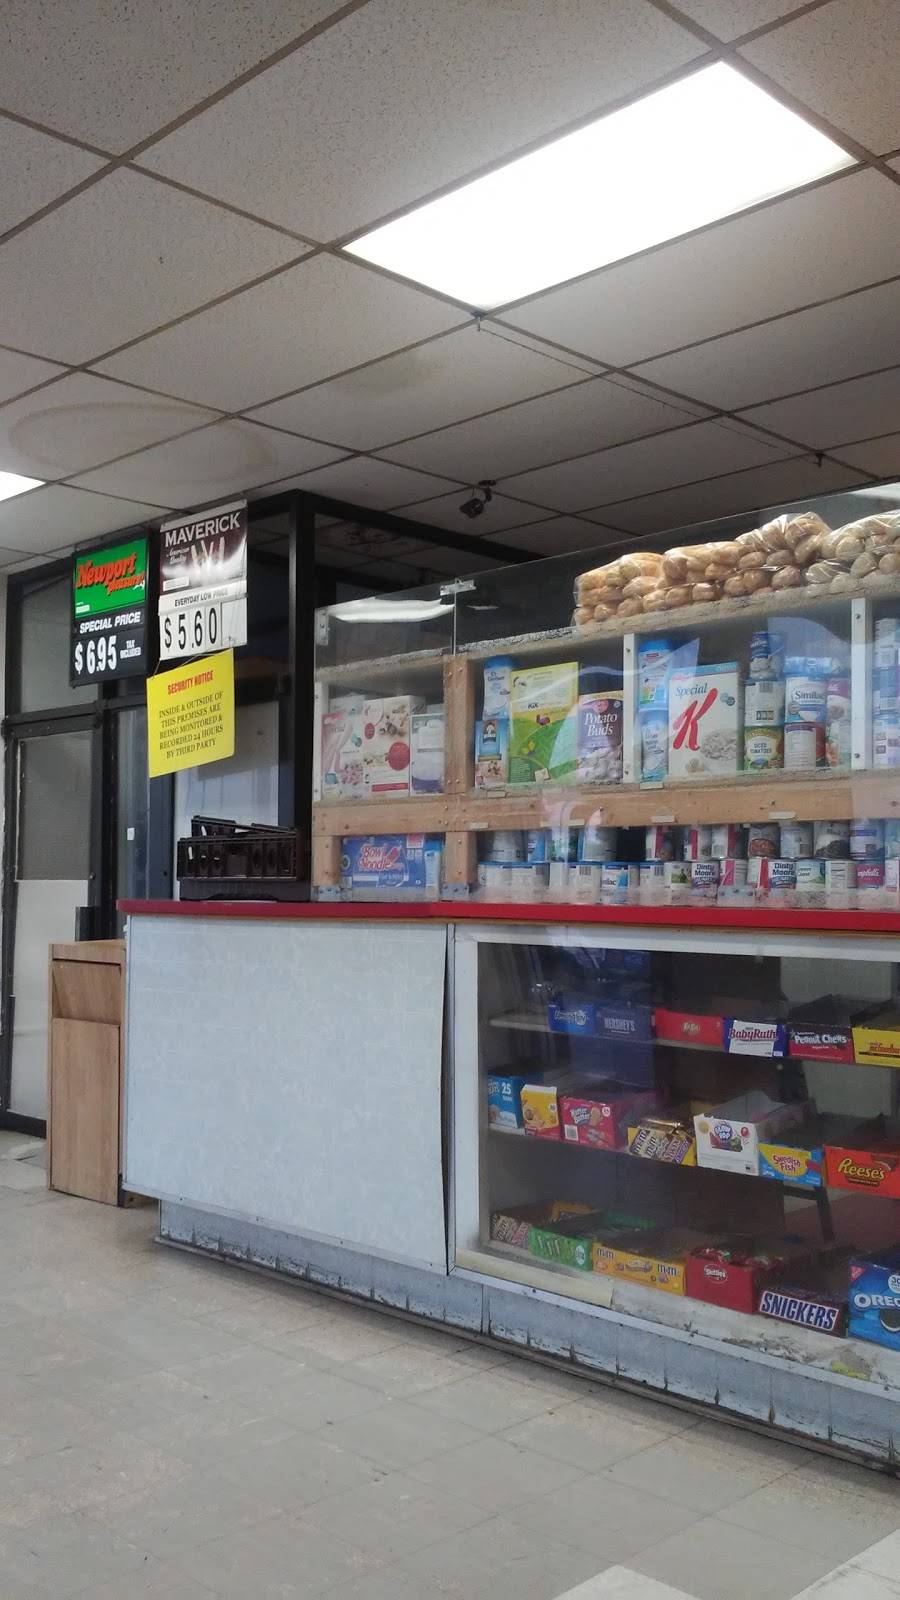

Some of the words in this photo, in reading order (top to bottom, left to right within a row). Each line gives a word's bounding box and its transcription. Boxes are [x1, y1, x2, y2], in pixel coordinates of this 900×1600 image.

[165, 512, 240, 547] MAVERICK
[76, 552, 137, 589] Newport
[174, 595, 199, 607] EVERYDAY
[200, 593, 212, 601] LOW
[80, 617, 113, 634] SPECIAL
[114, 611, 141, 627] PRICE
[168, 677, 193, 695] SECURITY
[194, 670, 213, 686] NOTICE
[676, 682, 708, 699] Special
[159, 704, 181, 719] INSIDE
[181, 702, 186, 711] &
[186, 693, 214, 709] OUTSIDE
[215, 691, 223, 700] OF
[161, 718, 176, 729] THIS
[177, 707, 208, 723] PREMISES
[209, 702, 221, 713] ARE
[584, 712, 618, 725] Potato
[672, 687, 718, 751] K
[159, 734, 193, 750] RECORDED
[193, 732, 201, 741] 24
[201, 724, 223, 739] HOURS
[160, 727, 179, 740] BEING
[180, 715, 217, 734] MONITORED
[587, 723, 614, 737] Buds
[166, 749, 174, 759] BY
[176, 744, 195, 757] THIRD
[196, 737, 216, 751] PARTY
[696, 863, 715, 872] Dinty
[774, 862, 794, 871] Dinty
[604, 1017, 636, 1032] HERSHEY'S
[794, 1034, 821, 1045] Peanut
[822, 1033, 847, 1044] Chews
[501, 1082, 512, 1095] 25
[772, 1155, 801, 1168] Swedish
[780, 1163, 796, 1173] Fish
[761, 1291, 836, 1331] SNICKERS
